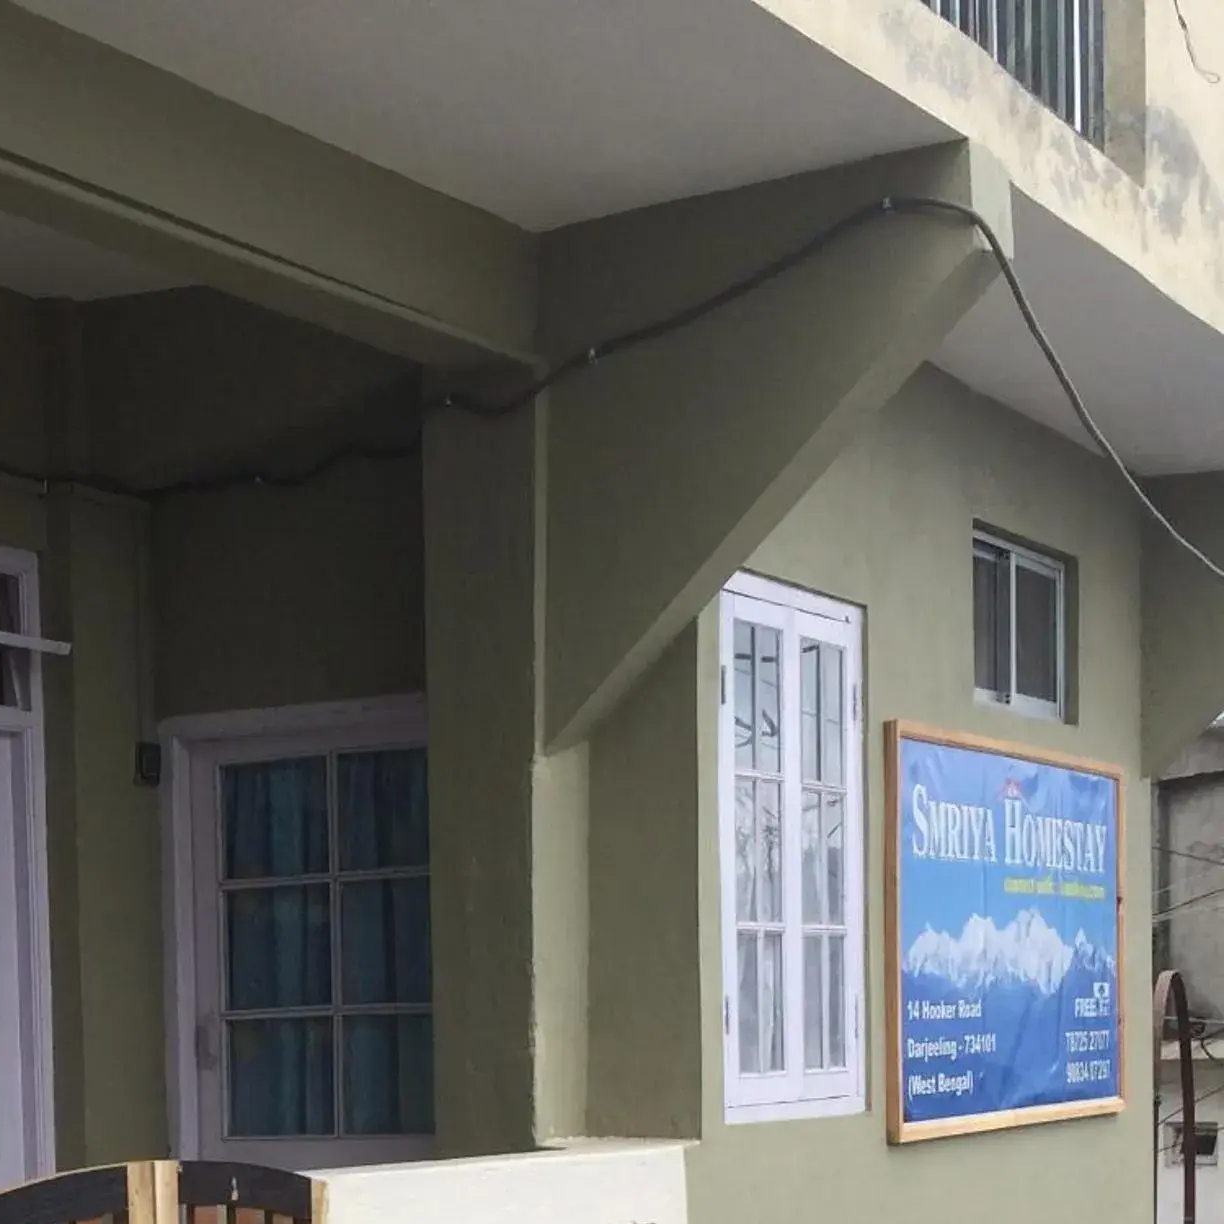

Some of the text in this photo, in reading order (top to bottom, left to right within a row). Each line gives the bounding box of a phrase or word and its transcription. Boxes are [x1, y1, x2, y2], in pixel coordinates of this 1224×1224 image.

[912, 784, 1107, 873] SMRIYA HOMESTAY
[907, 999, 982, 1020] 14 Hooker Road
[907, 1038, 957, 1062] Darjeeling
[964, 1033, 996, 1055] 734101
[908, 1070, 974, 1100] (West Bengal)
